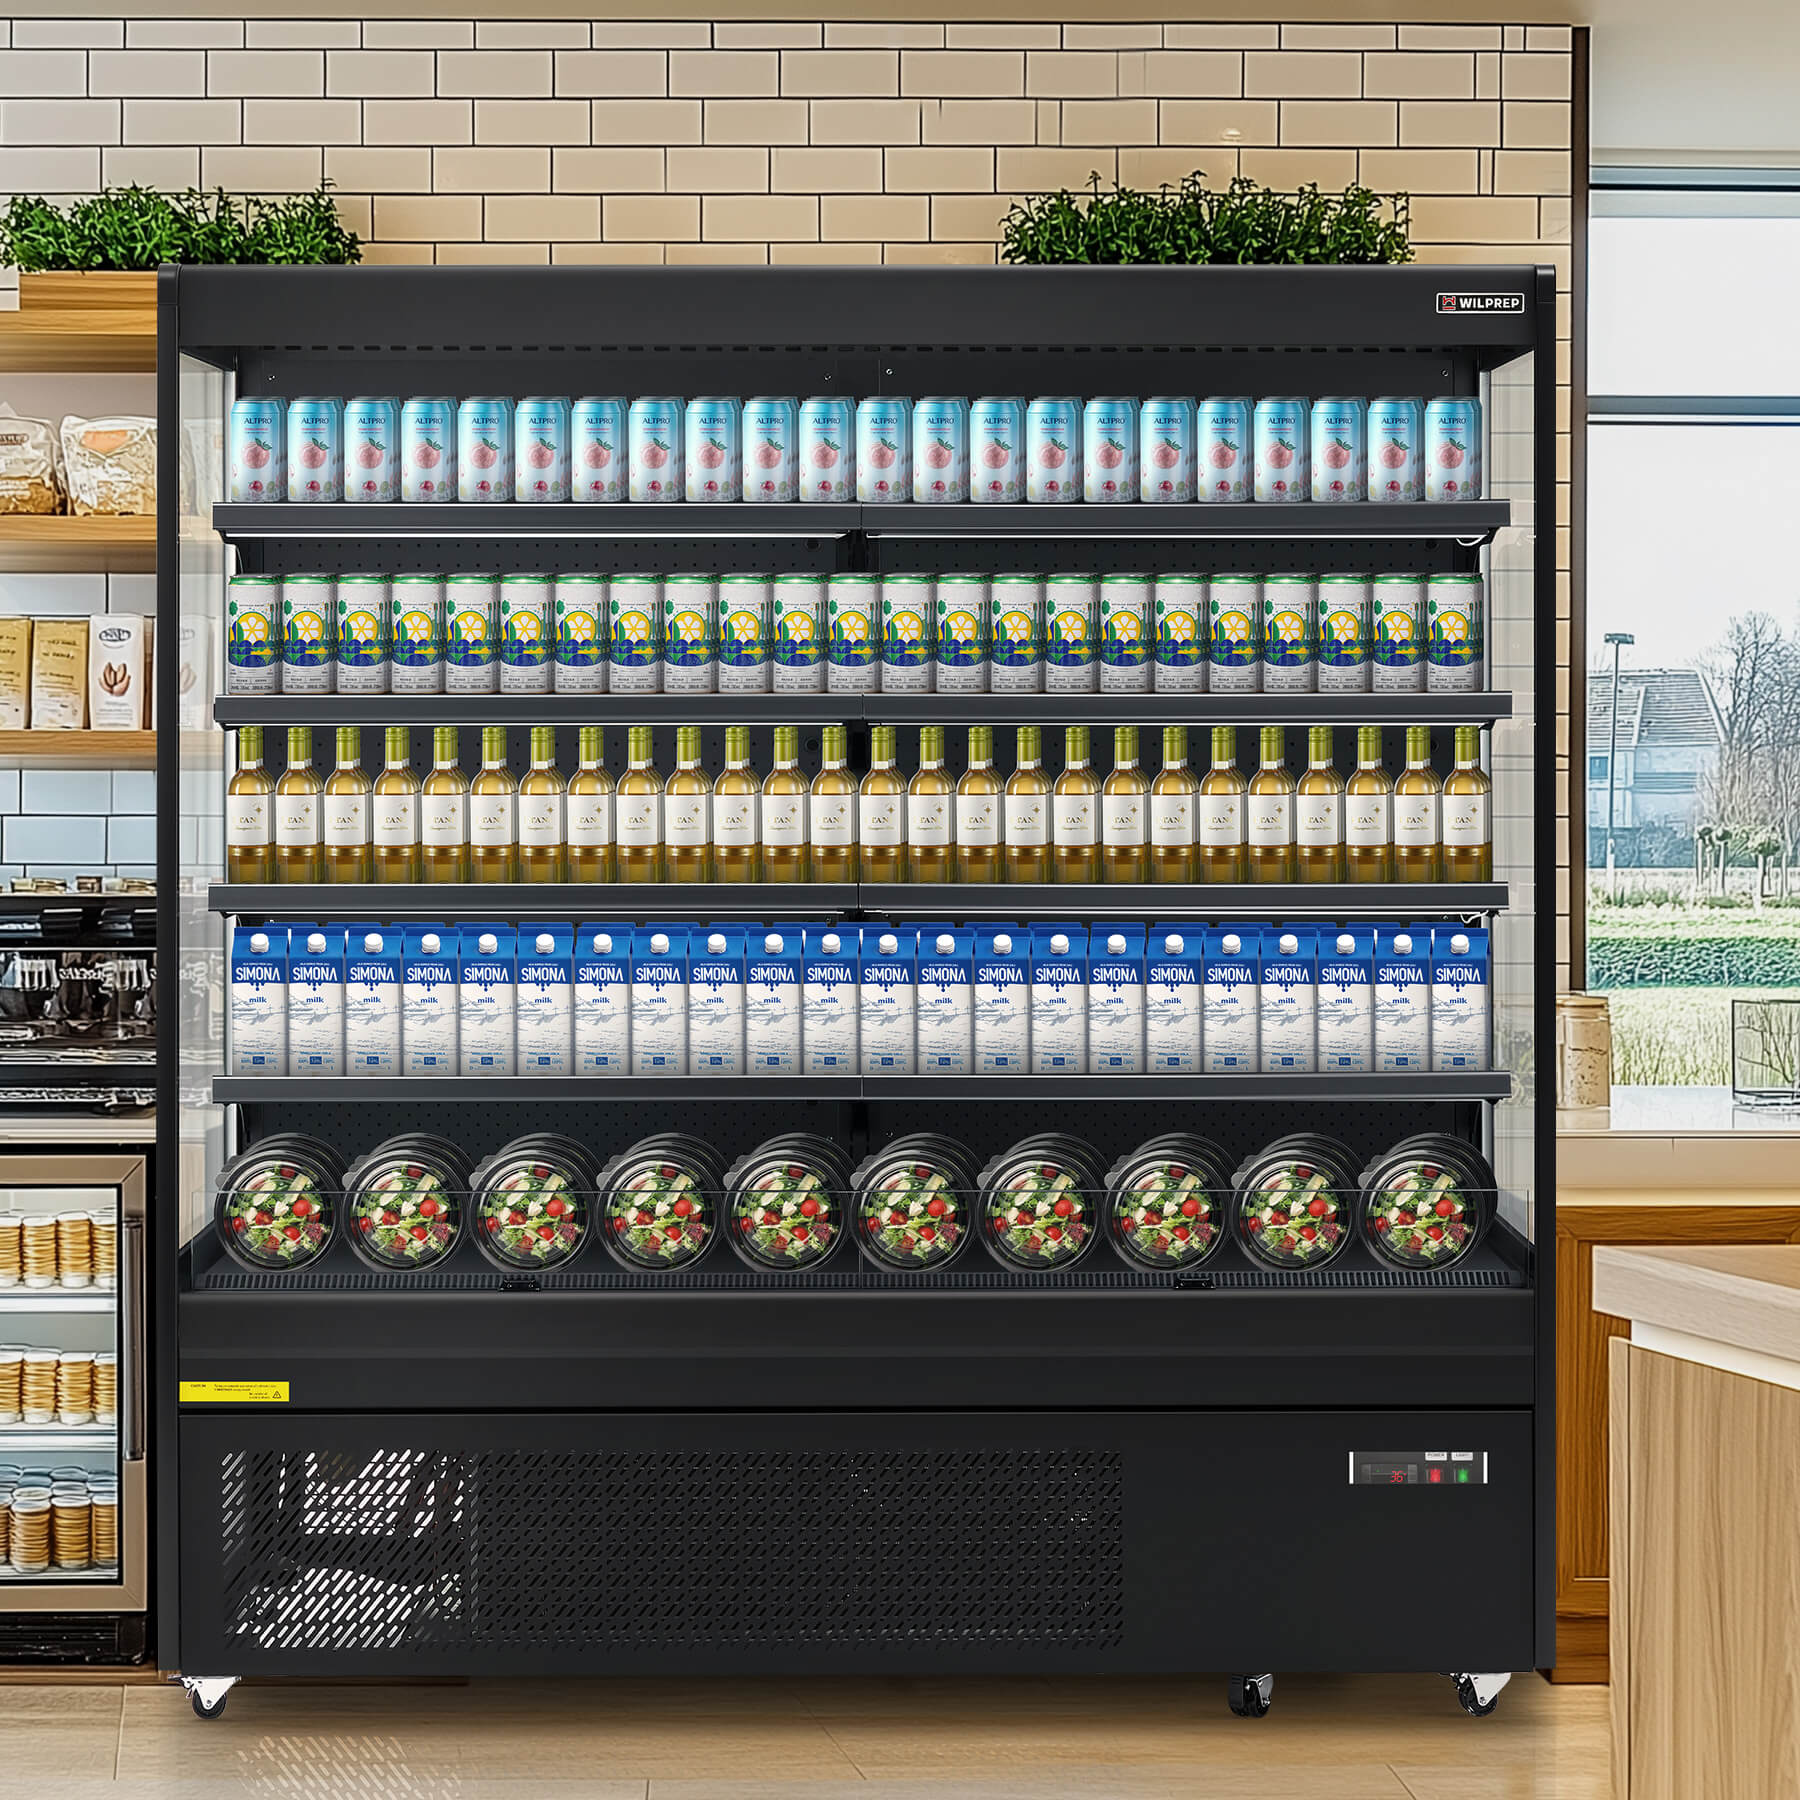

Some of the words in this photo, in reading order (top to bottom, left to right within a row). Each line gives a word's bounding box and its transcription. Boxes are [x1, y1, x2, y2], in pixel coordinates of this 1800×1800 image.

[1459, 297, 1520, 309] WILPREP
[244, 417, 272, 425] ALTPRO
[301, 417, 329, 425] ALTPRO
[358, 417, 386, 425] ALTPRO
[415, 417, 443, 425] ALTPRO
[471, 417, 499, 425] ALTPRO
[529, 417, 557, 425] ALTPRO
[585, 417, 613, 425] ALTPRO
[642, 417, 670, 425] ALTPRO
[699, 417, 727, 425] ALTPRO
[756, 417, 784, 425] ALTPRO
[813, 417, 841, 425] ALTPRO
[870, 417, 898, 425] ALTPRO
[926, 417, 954, 425] ALTPRO
[983, 417, 1011, 425] ALTPRO
[1040, 417, 1068, 425] ALTPRO
[1097, 417, 1125, 425] ALTPRO
[1154, 417, 1182, 425] ALTPRO
[1211, 417, 1239, 425] ALTPRO
[1267, 417, 1295, 425] ALTPRO
[1325, 417, 1353, 425] ALTPRO
[1381, 417, 1409, 425] ALTPRO
[1438, 417, 1466, 425] ALTPRO
[236, 967, 280, 981] SIMONA
[293, 967, 337, 981] SIMONA
[350, 967, 394, 981] SIMONA
[407, 967, 451, 981] SIMONA
[464, 967, 508, 981] SIMONA
[521, 967, 565, 981] SIMONA
[579, 967, 623, 981] SIMONA
[636, 967, 680, 981] SIMONA
[693, 967, 737, 981] SIMONA
[750, 967, 794, 981] SIMONA
[808, 968, 852, 982] SIMONA
[865, 968, 909, 982] SIMONA
[922, 968, 966, 982] SIMONA
[979, 968, 1023, 982] SIMONA
[1036, 968, 1080, 982] SIMONA
[1093, 968, 1137, 982] SIMONA
[1151, 968, 1195, 982] SIMONA
[1208, 968, 1252, 982] SIMONA
[1265, 968, 1309, 982] SIMONA
[1322, 968, 1366, 982] SIMONA
[1379, 968, 1423, 982] SIMONA
[1436, 968, 1480, 982] SIMONA
